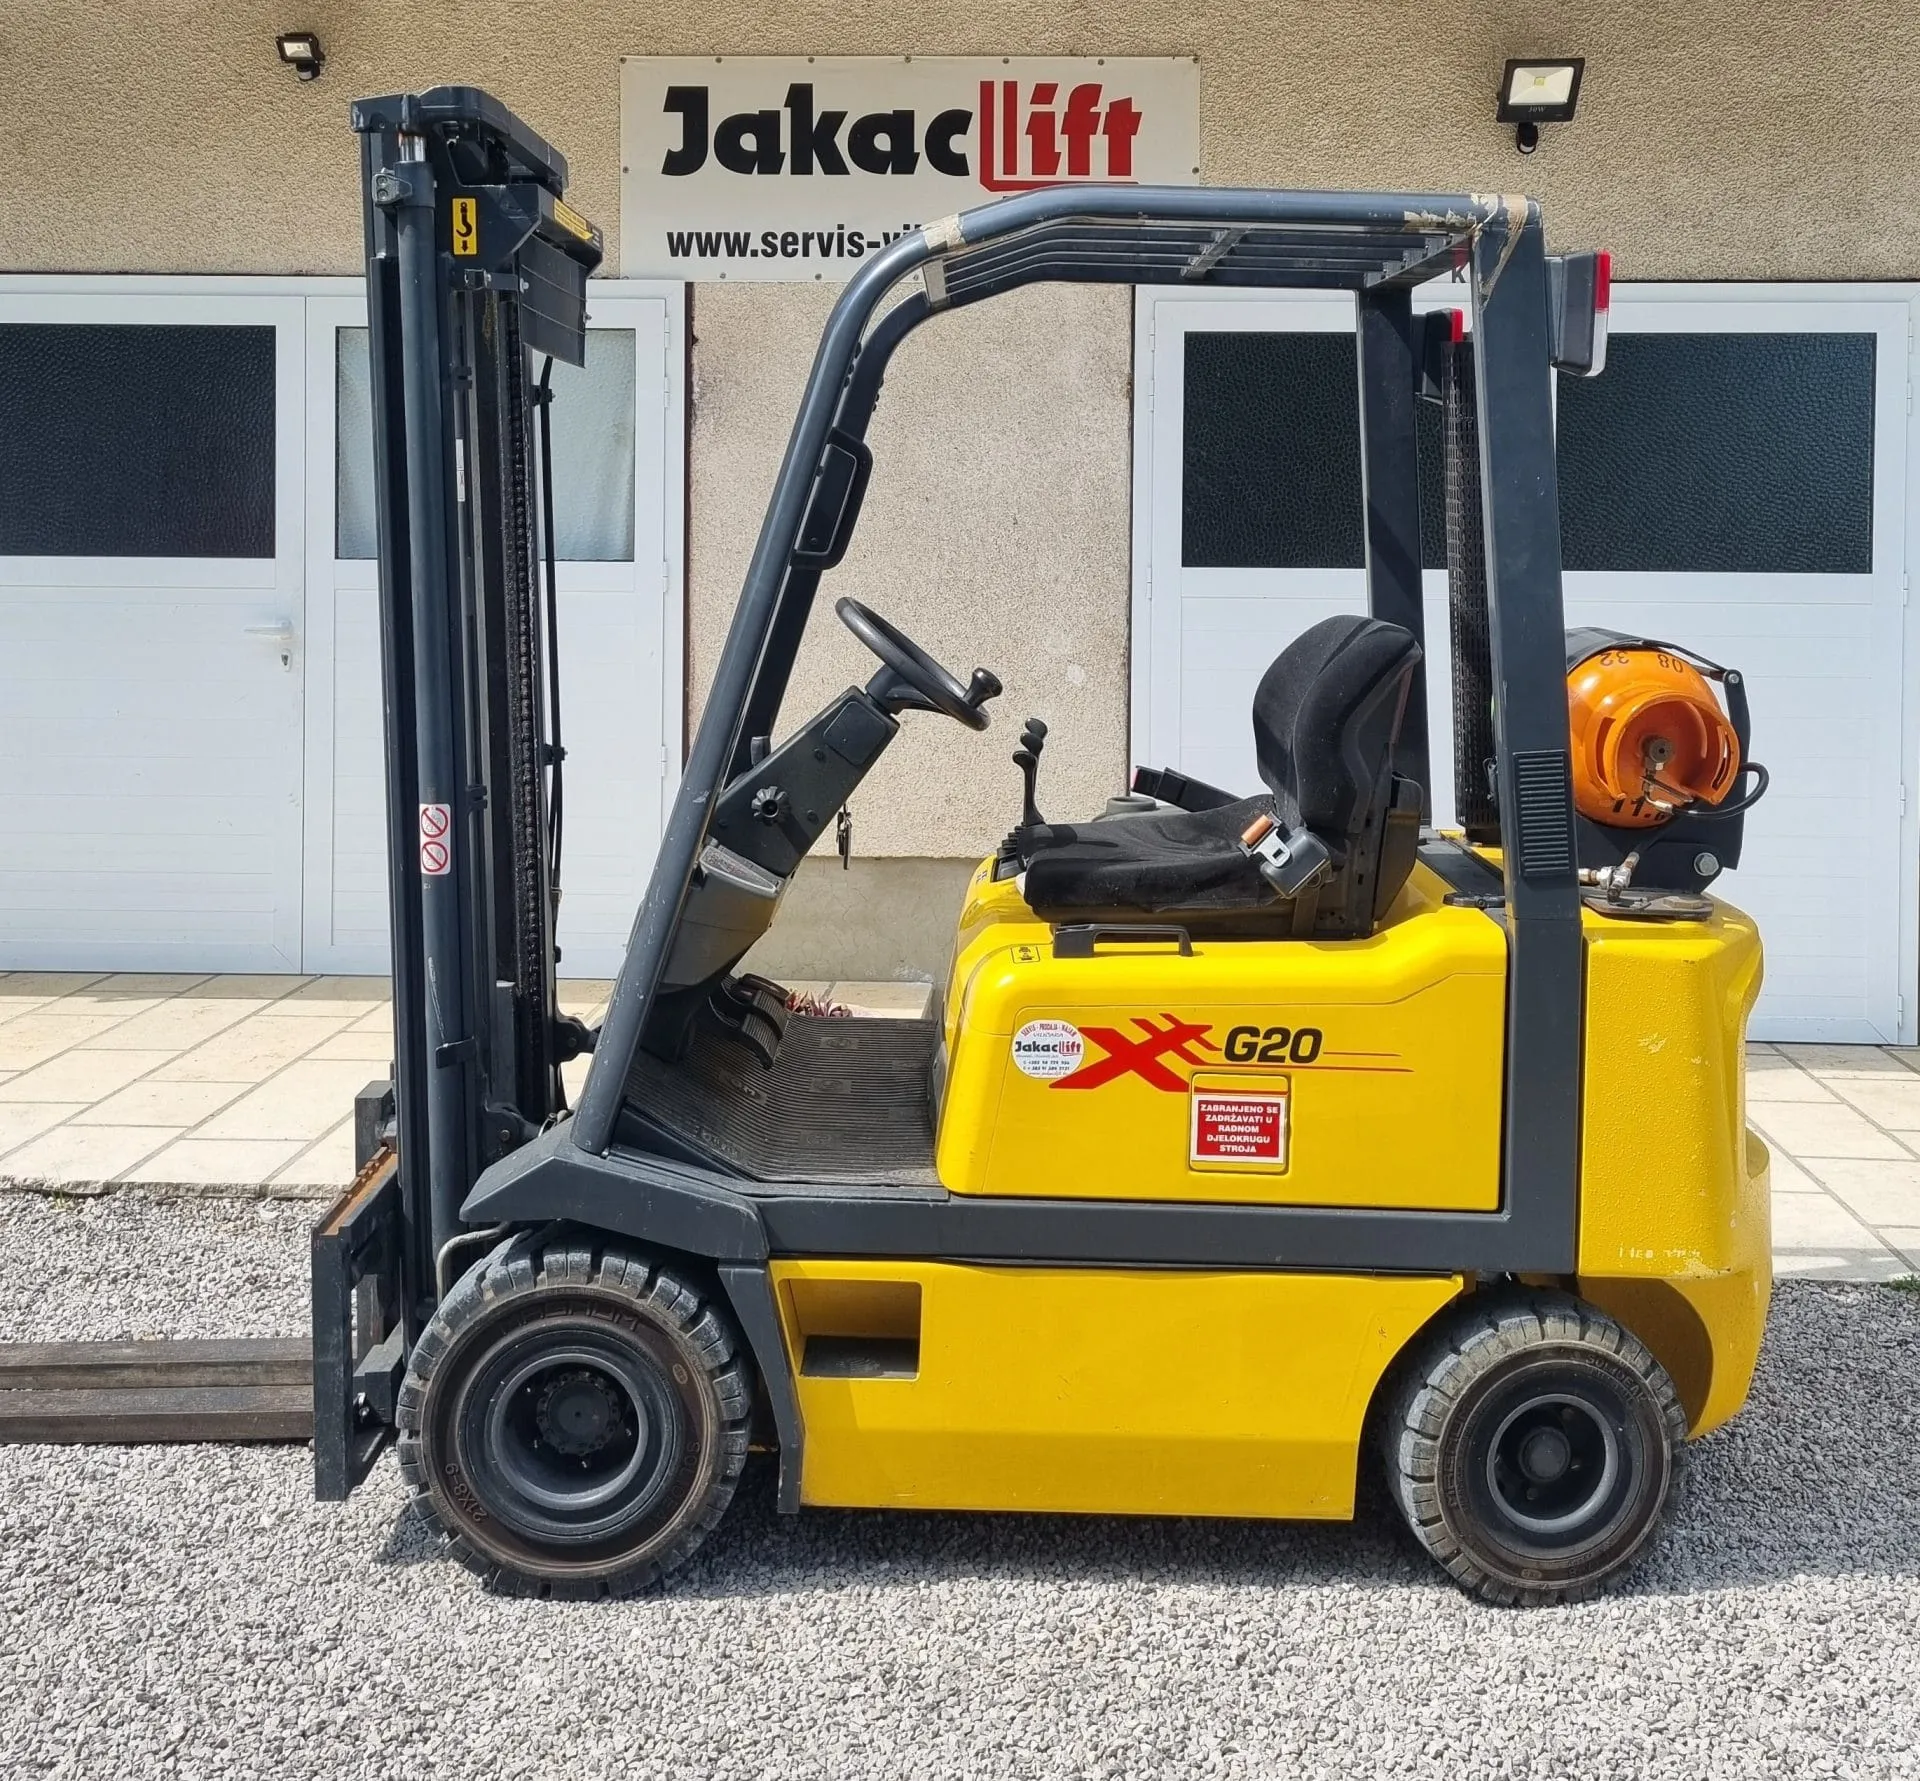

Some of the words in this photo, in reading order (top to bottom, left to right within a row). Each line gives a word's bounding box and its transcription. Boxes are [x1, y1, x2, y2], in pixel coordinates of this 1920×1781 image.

[1224, 1025, 1323, 1064] G20
[1200, 1104, 1264, 1113] ZABRANJENO
[1266, 1106, 1279, 1114] SE
[1205, 1113, 1264, 1123] ZADRŽAVATI
[1218, 1125, 1260, 1133] RADNOM
[1206, 1134, 1271, 1143] DJELOKRUGU
[1219, 1144, 1257, 1153] STROJA
